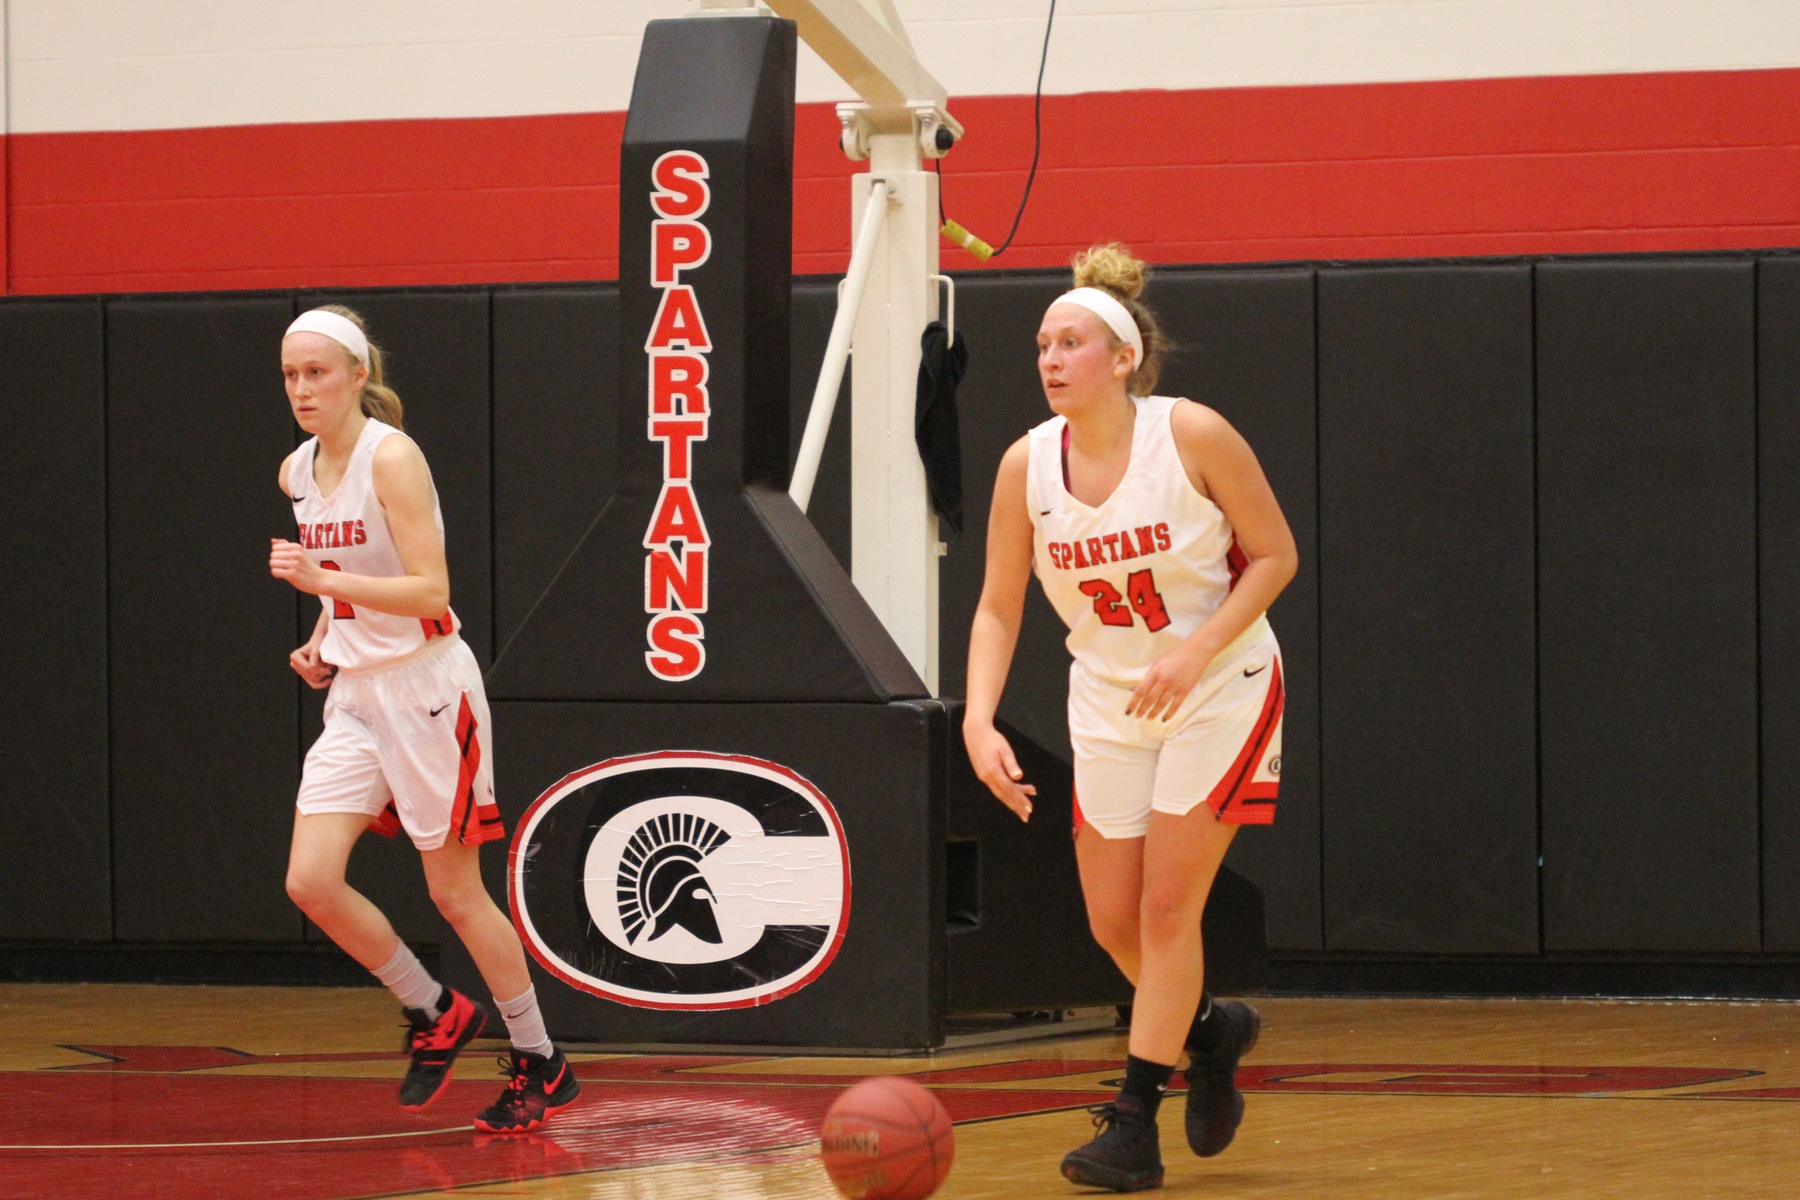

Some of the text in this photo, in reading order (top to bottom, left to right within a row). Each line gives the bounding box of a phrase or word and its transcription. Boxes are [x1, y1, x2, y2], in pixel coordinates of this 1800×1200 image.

[644, 149, 712, 682] SPARTANS
[298, 519, 368, 550] PARTANS
[1048, 522, 1172, 570] SPARTANS
[1078, 568, 1172, 633] 24
